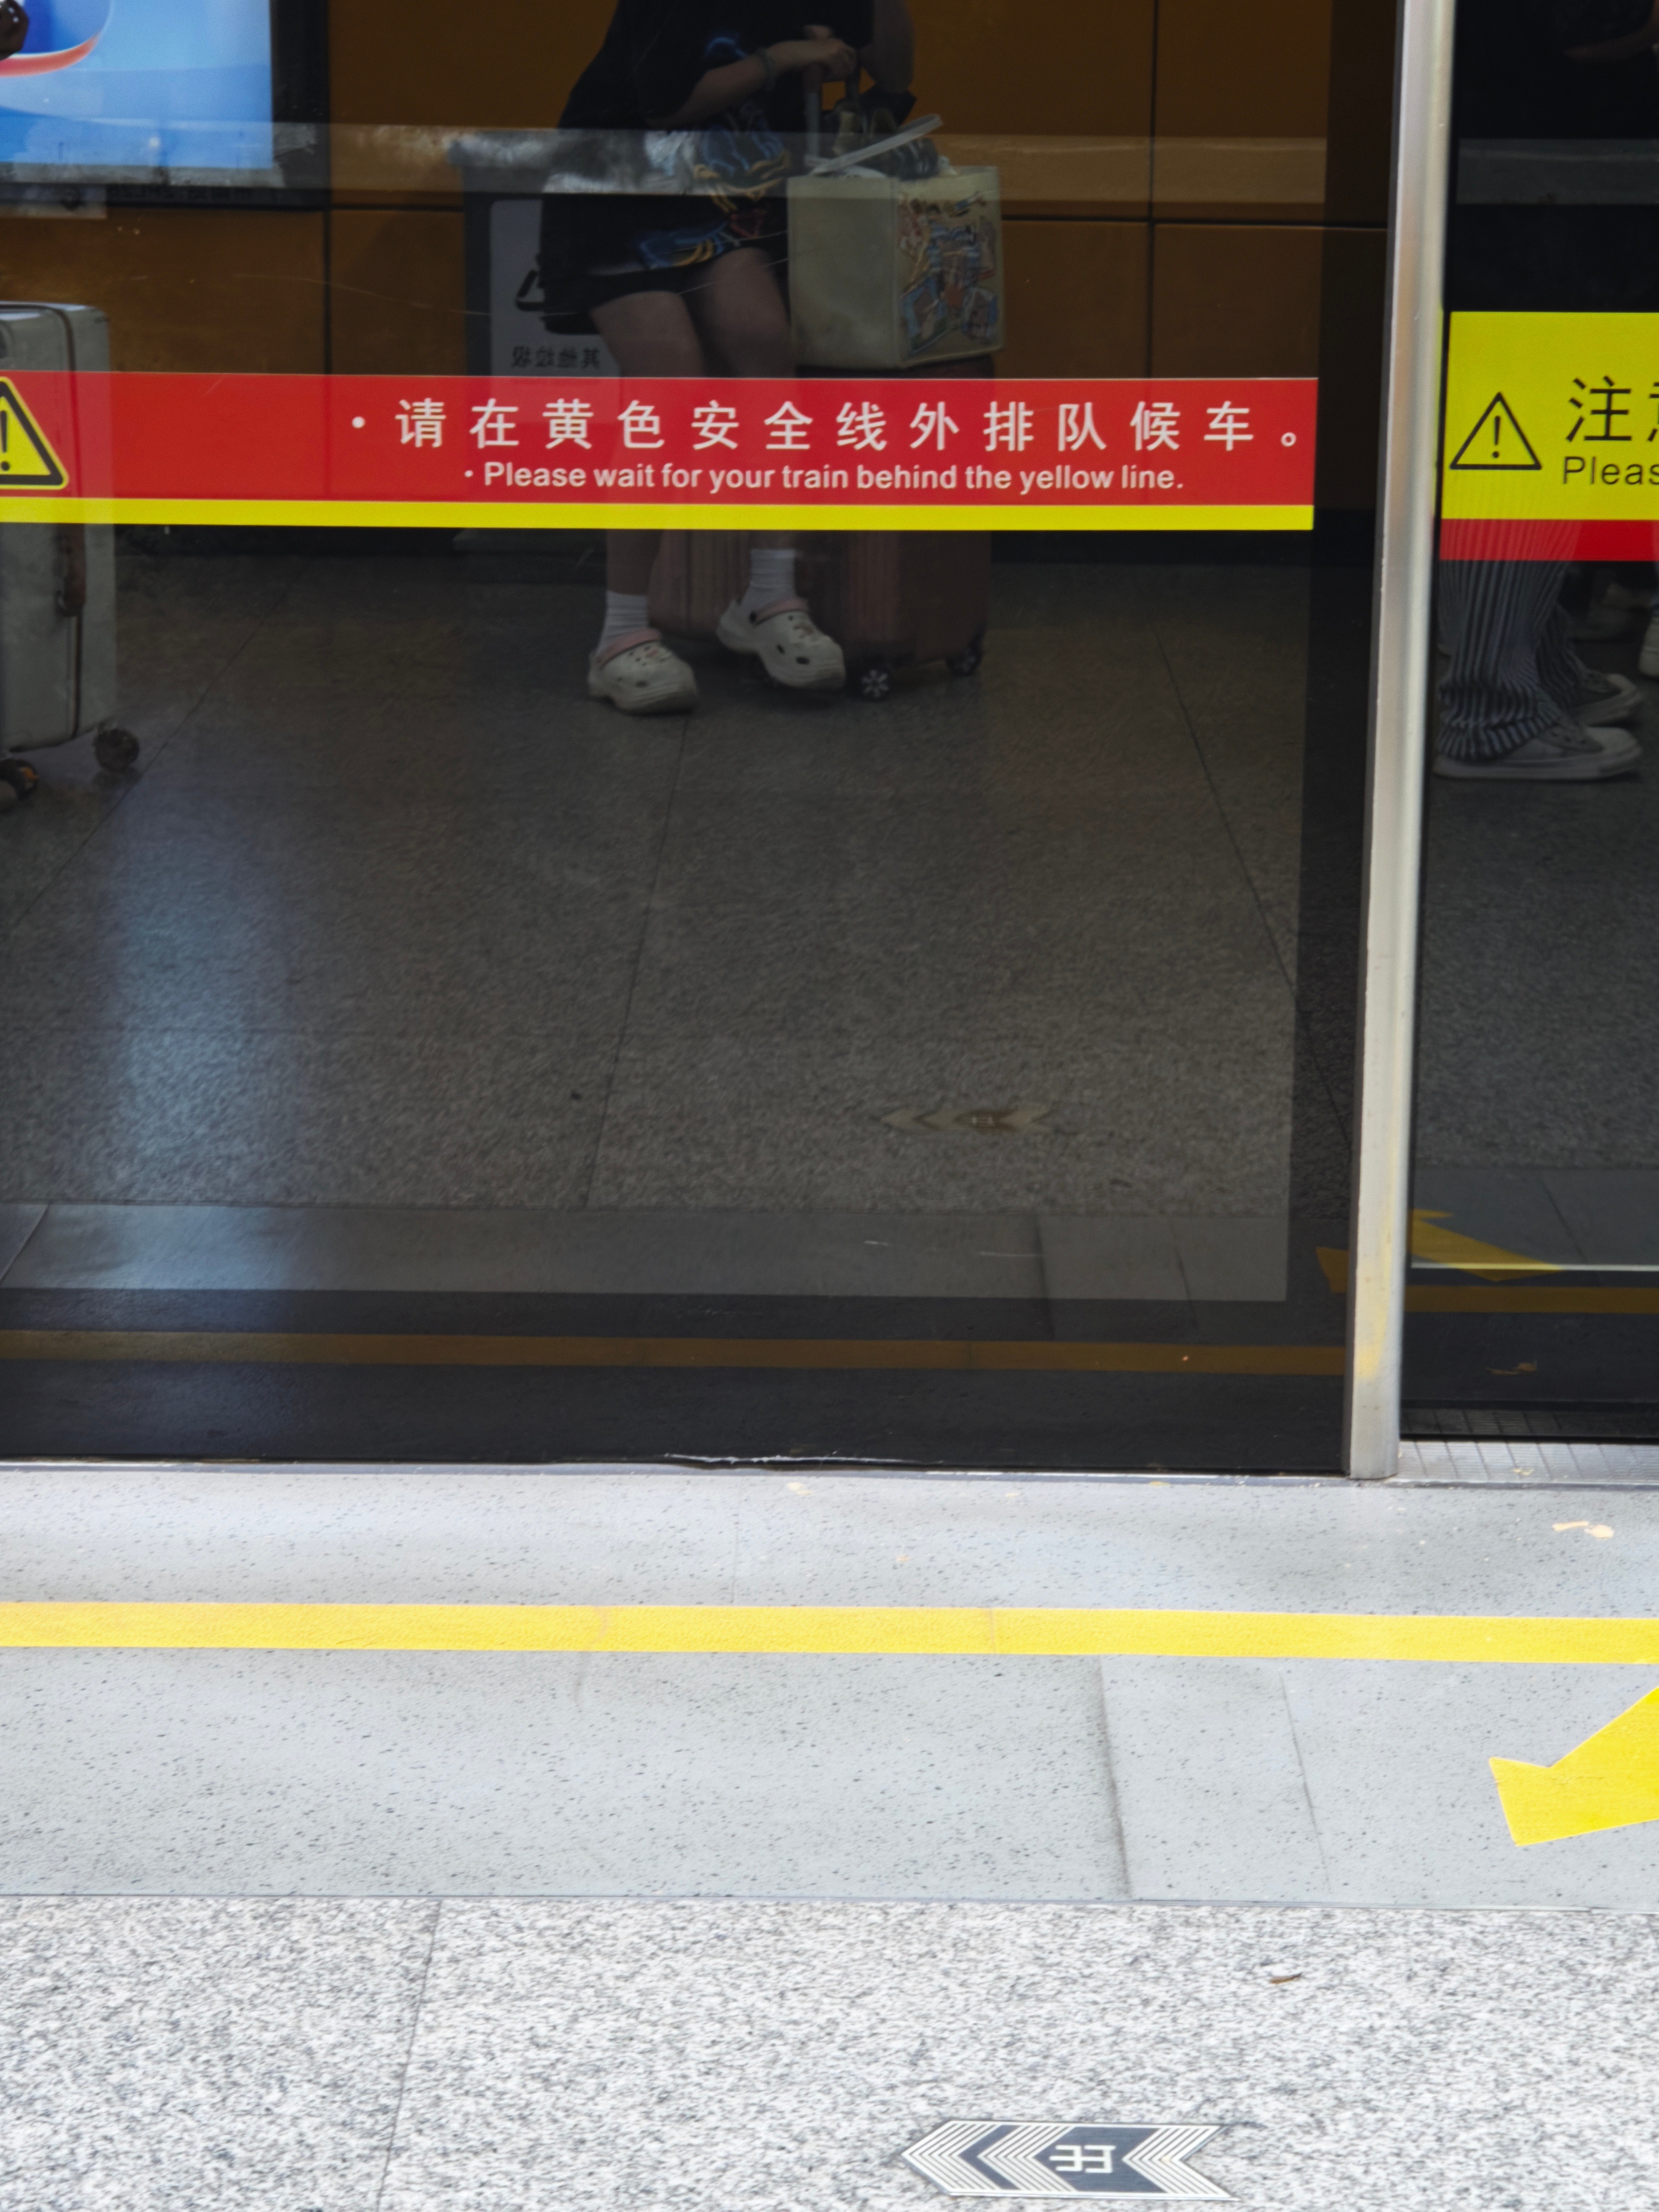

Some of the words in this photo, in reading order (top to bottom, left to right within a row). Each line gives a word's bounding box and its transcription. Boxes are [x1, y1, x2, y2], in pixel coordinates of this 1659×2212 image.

[394, 397, 1297, 451] 请在黄色安全线外排队候车。
[1566, 376, 1659, 442] 注
[484, 461, 587, 488] Please
[592, 463, 655, 488] wait
[660, 462, 703, 488] for
[708, 469, 775, 495] your
[781, 464, 849, 489] train
[857, 464, 957, 489] behind
[965, 464, 1013, 489] the
[1019, 464, 1115, 496] yellow
[1121, 464, 1184, 489] line.
